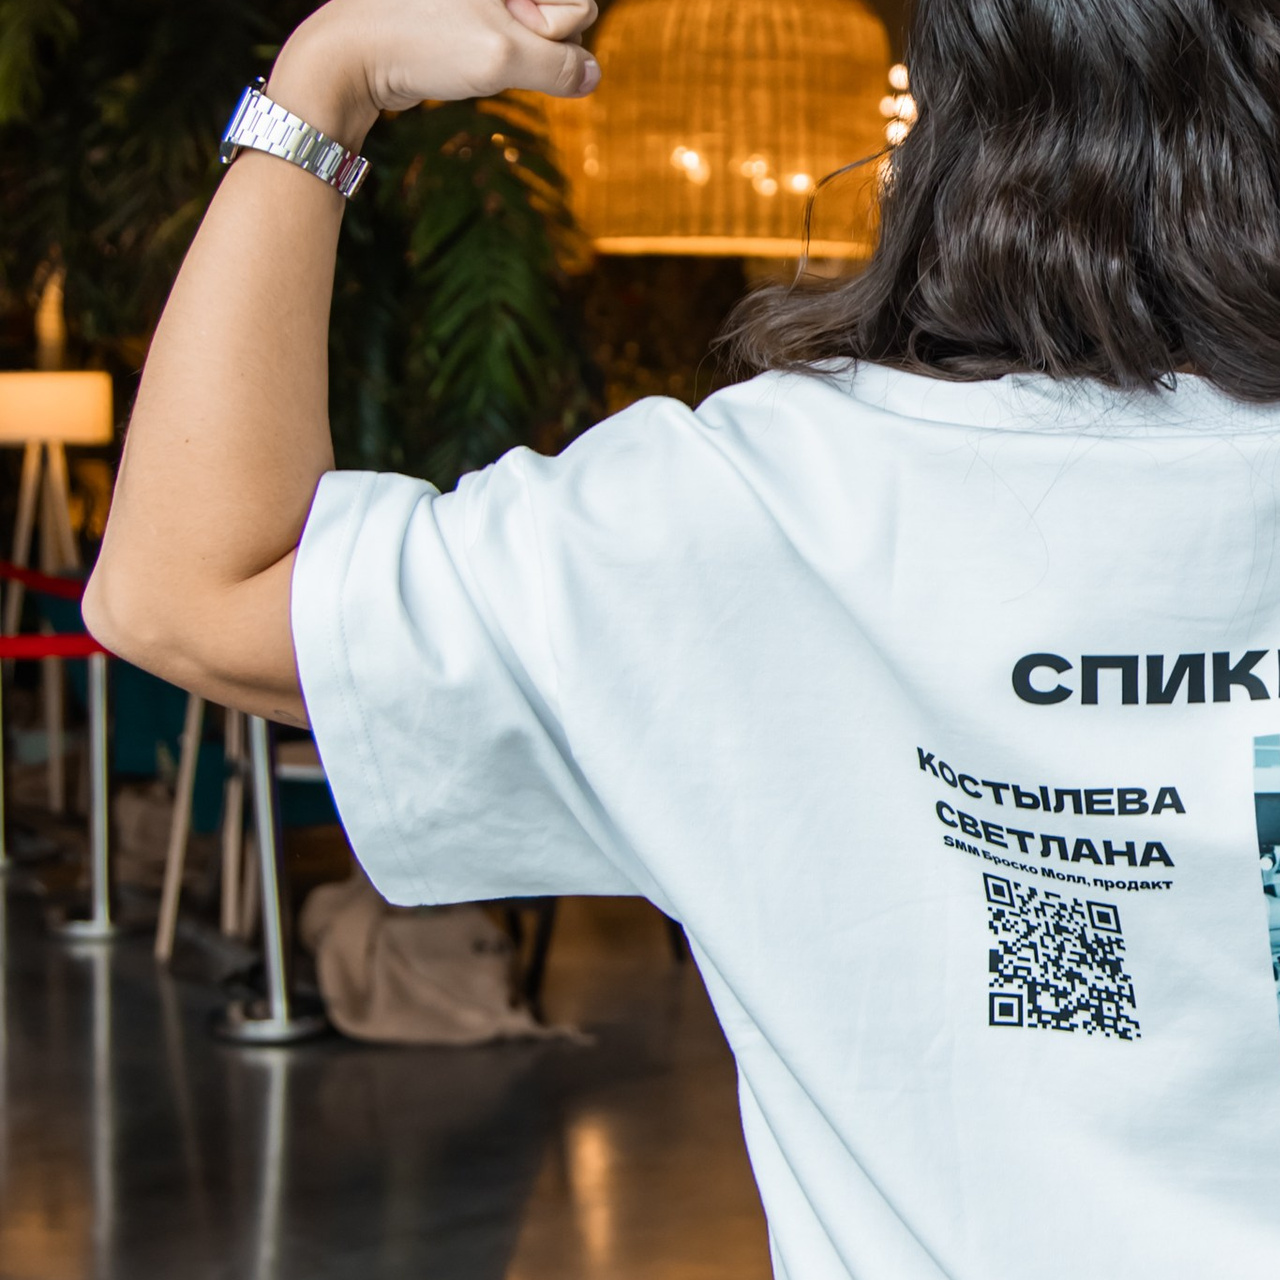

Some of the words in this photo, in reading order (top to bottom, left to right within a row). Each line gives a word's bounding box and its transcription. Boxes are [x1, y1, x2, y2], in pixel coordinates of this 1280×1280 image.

[917, 746, 1186, 816] КОСТЫЛЕВА
[935, 800, 1175, 867] СВЕТЛАНА
[943, 835, 981, 857] SMM
[982, 850, 1038, 875] Броско
[1041, 866, 1091, 887] Молл,
[1093, 877, 1173, 891] продакт
